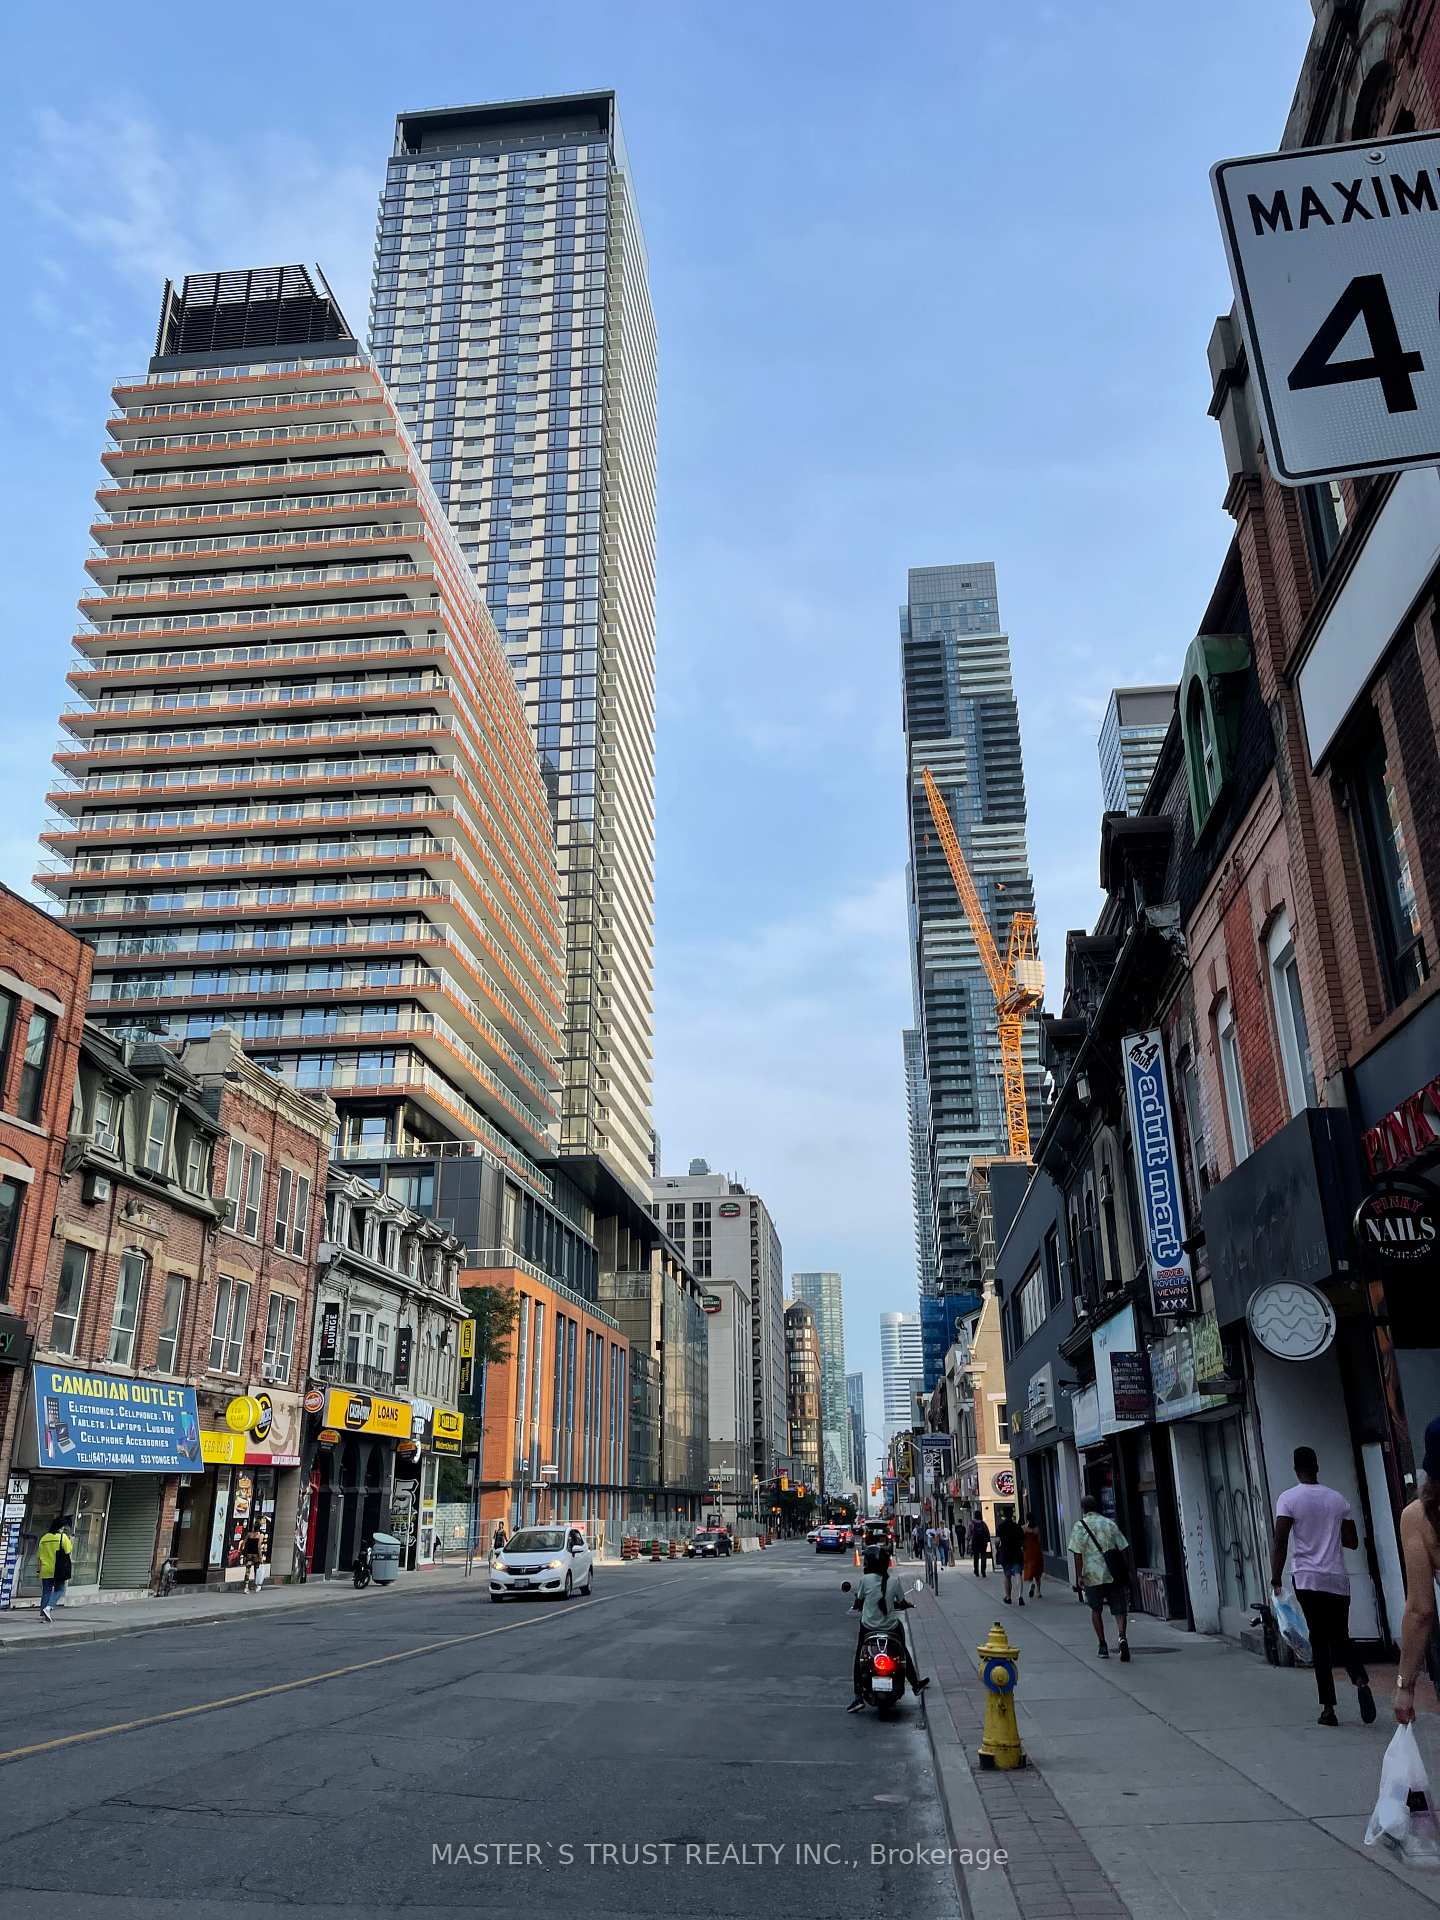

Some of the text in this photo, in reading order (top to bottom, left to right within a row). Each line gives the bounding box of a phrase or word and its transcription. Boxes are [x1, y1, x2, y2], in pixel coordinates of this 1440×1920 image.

[1247, 168, 1440, 236] MAXIM
[1287, 273, 1440, 415] 4
[1128, 1049, 1151, 1070] HOUR
[1130, 1035, 1160, 1061] 24
[1138, 1075, 1180, 1259] adult mart
[1365, 1216, 1436, 1242] NAILS
[1157, 1267, 1185, 1279] MOVIES
[1158, 1286, 1189, 1297] VIEWING
[327, 1313, 337, 1349] LOUNGE
[51, 1374, 184, 1408] CANADIAN OUTLET
[377, 1405, 399, 1421] LOANS
